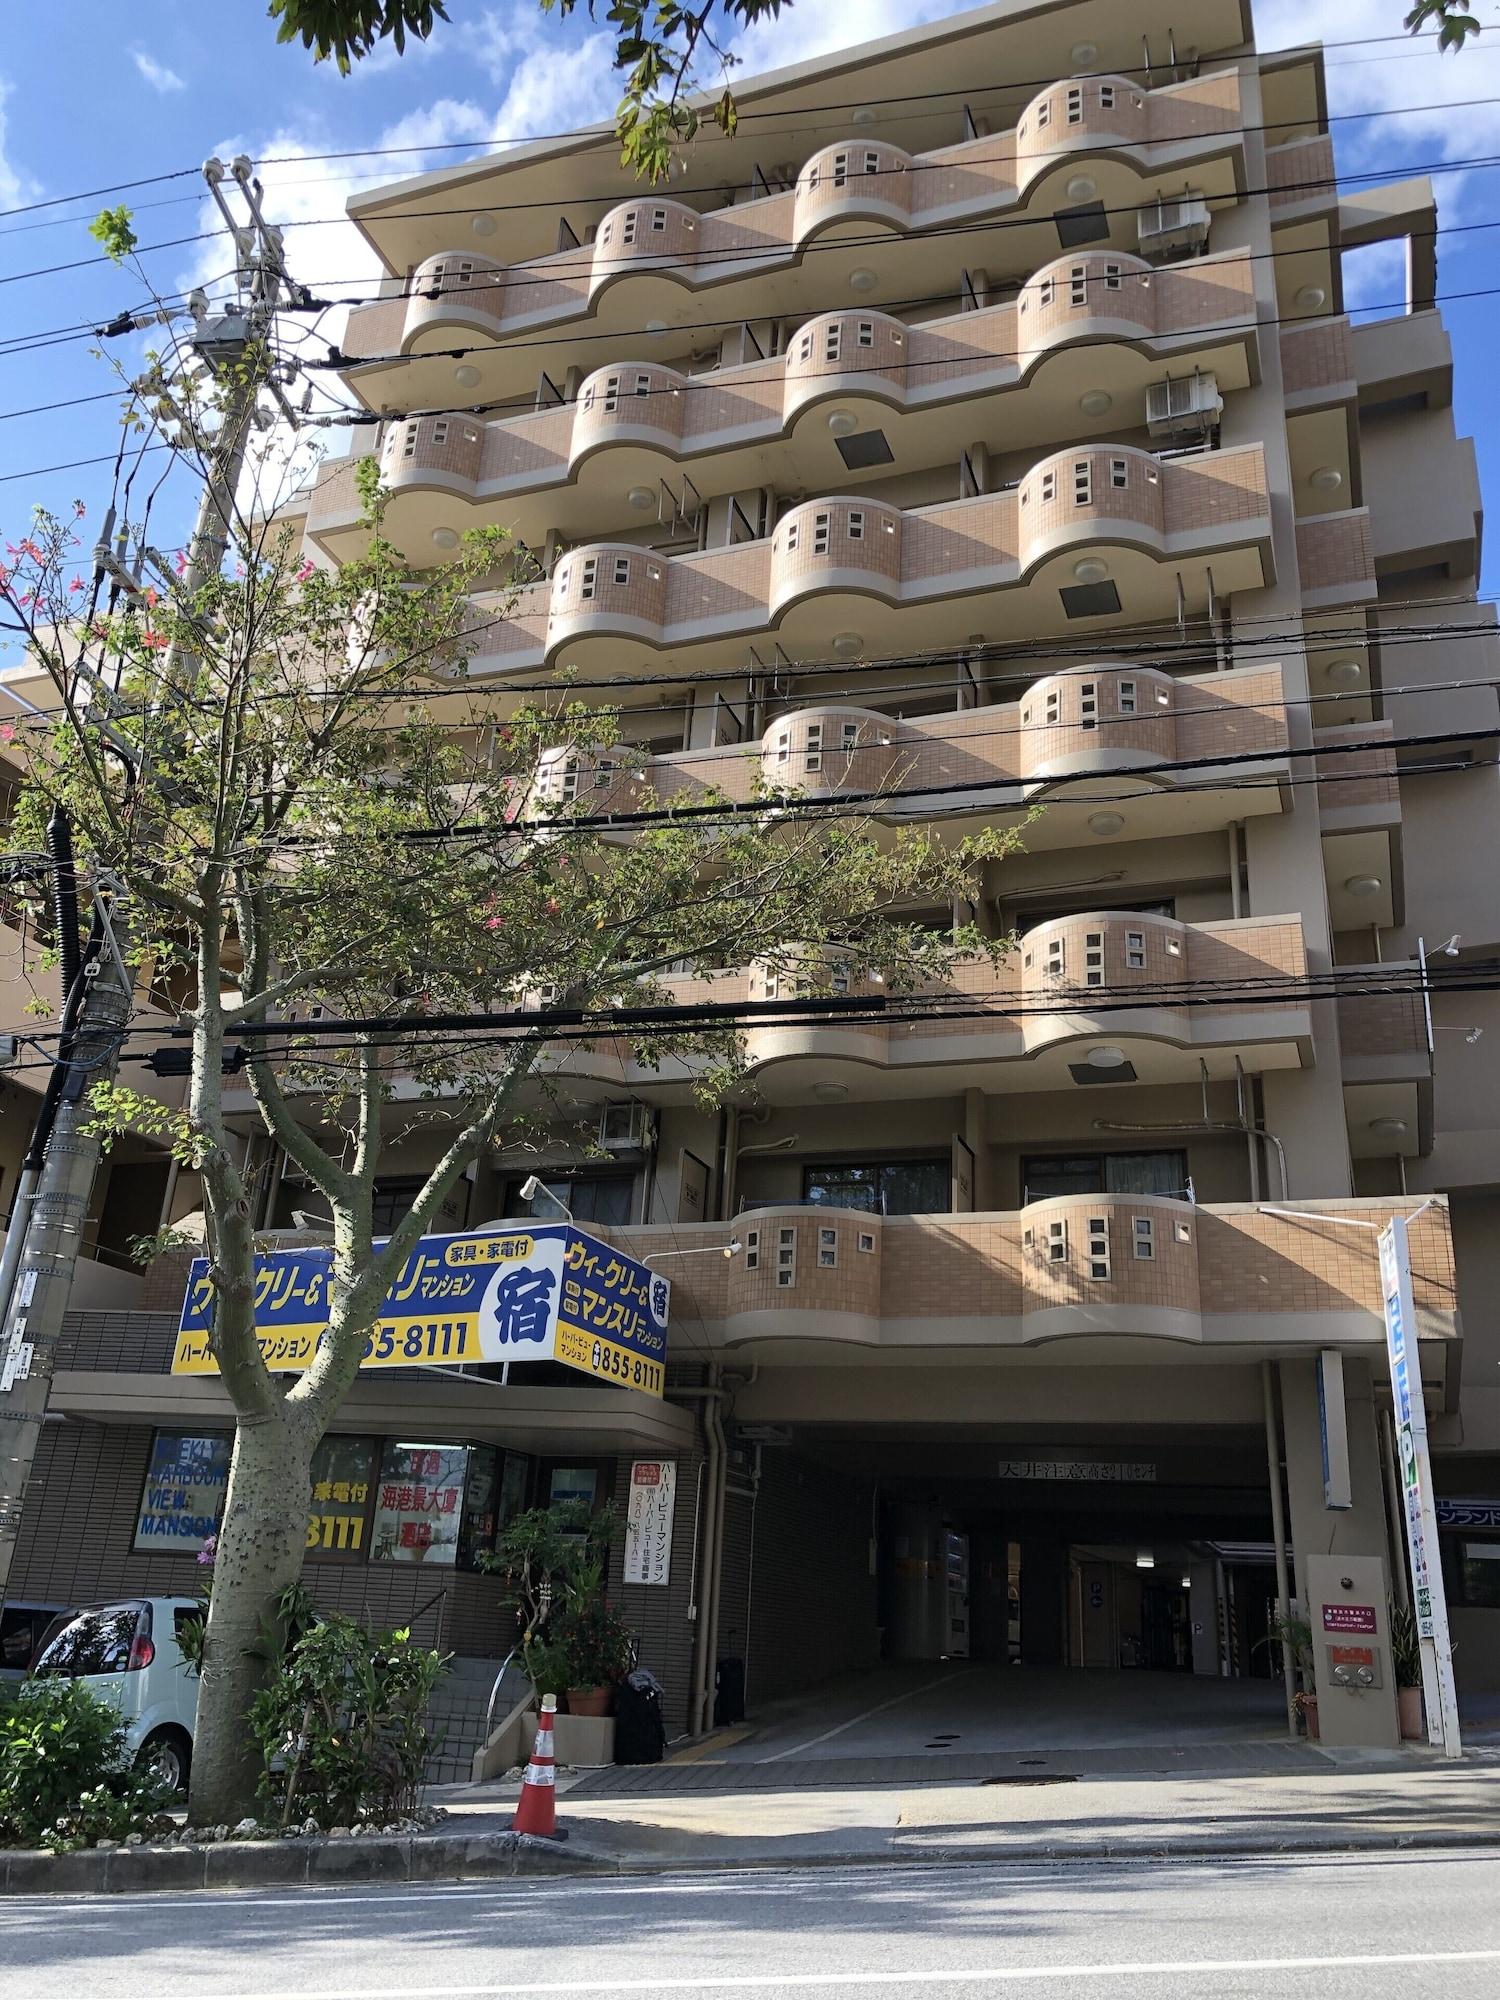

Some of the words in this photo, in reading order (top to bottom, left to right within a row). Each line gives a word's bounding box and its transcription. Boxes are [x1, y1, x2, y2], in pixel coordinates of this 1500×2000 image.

[450, 1240, 529, 1262] 家具・家電付
[421, 1273, 475, 1299] マンション
[494, 1266, 557, 1345] 宿
[582, 1287, 647, 1340] マンスリー
[560, 1343, 587, 1362] マンション
[602, 1347, 661, 1391] 855-8111
